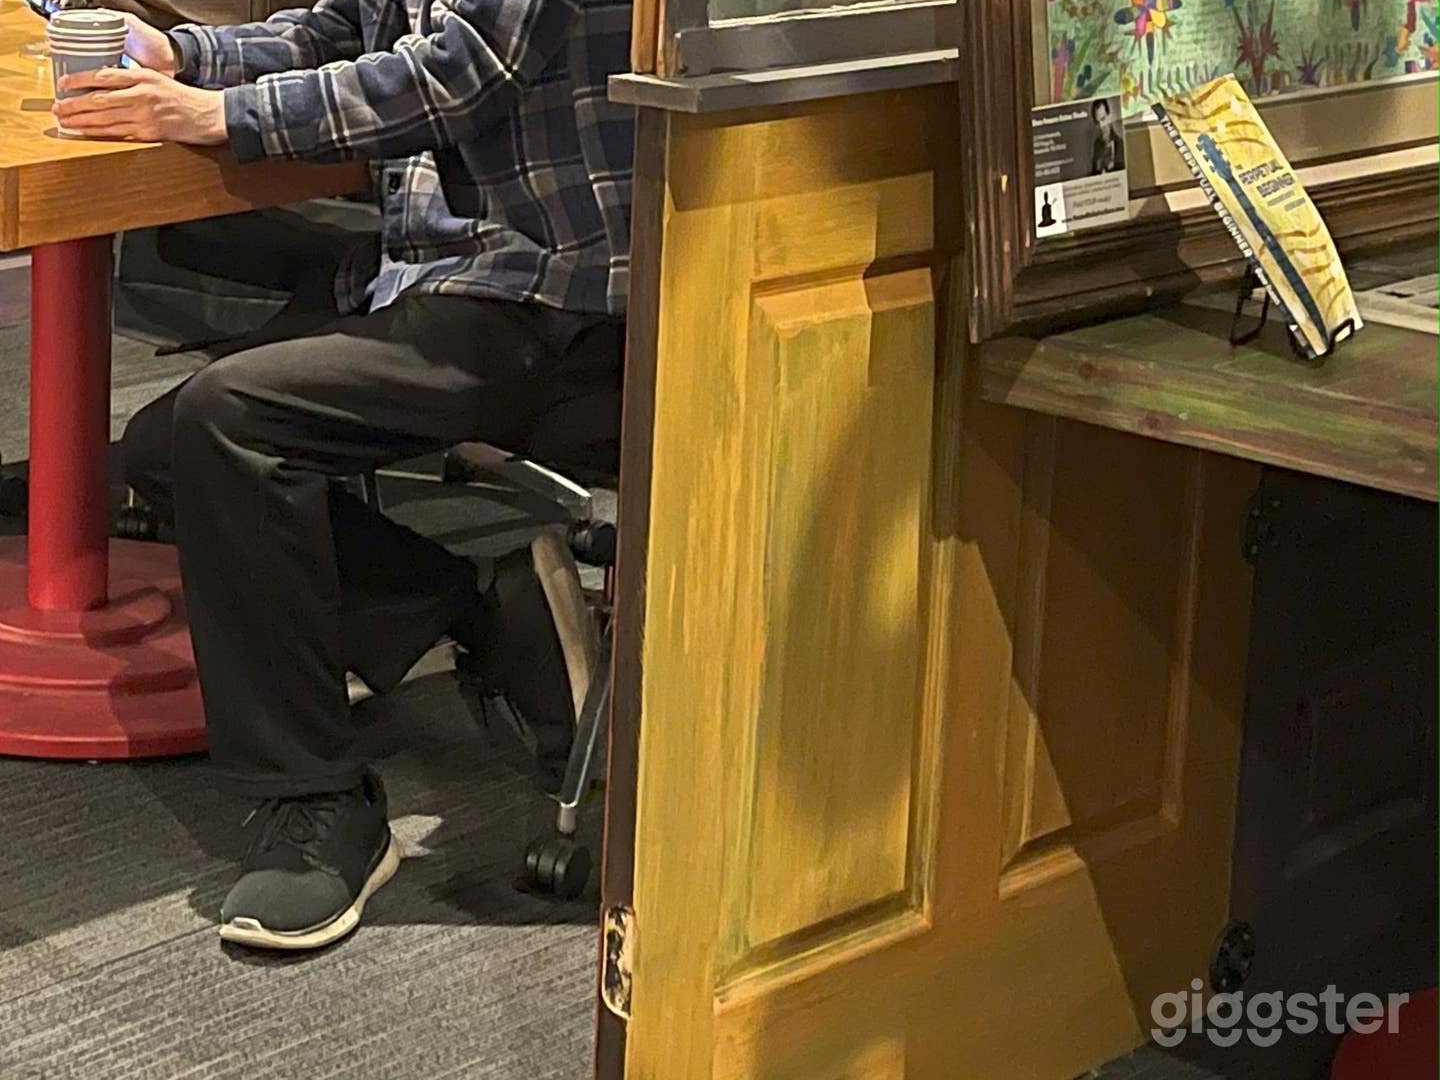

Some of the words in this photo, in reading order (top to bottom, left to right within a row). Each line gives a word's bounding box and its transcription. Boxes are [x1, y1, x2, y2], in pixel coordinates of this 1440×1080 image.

[1161, 115, 1178, 138] THE
[1175, 139, 1216, 203] PERPETUAL
[1214, 201, 1253, 258] BEGINNER
